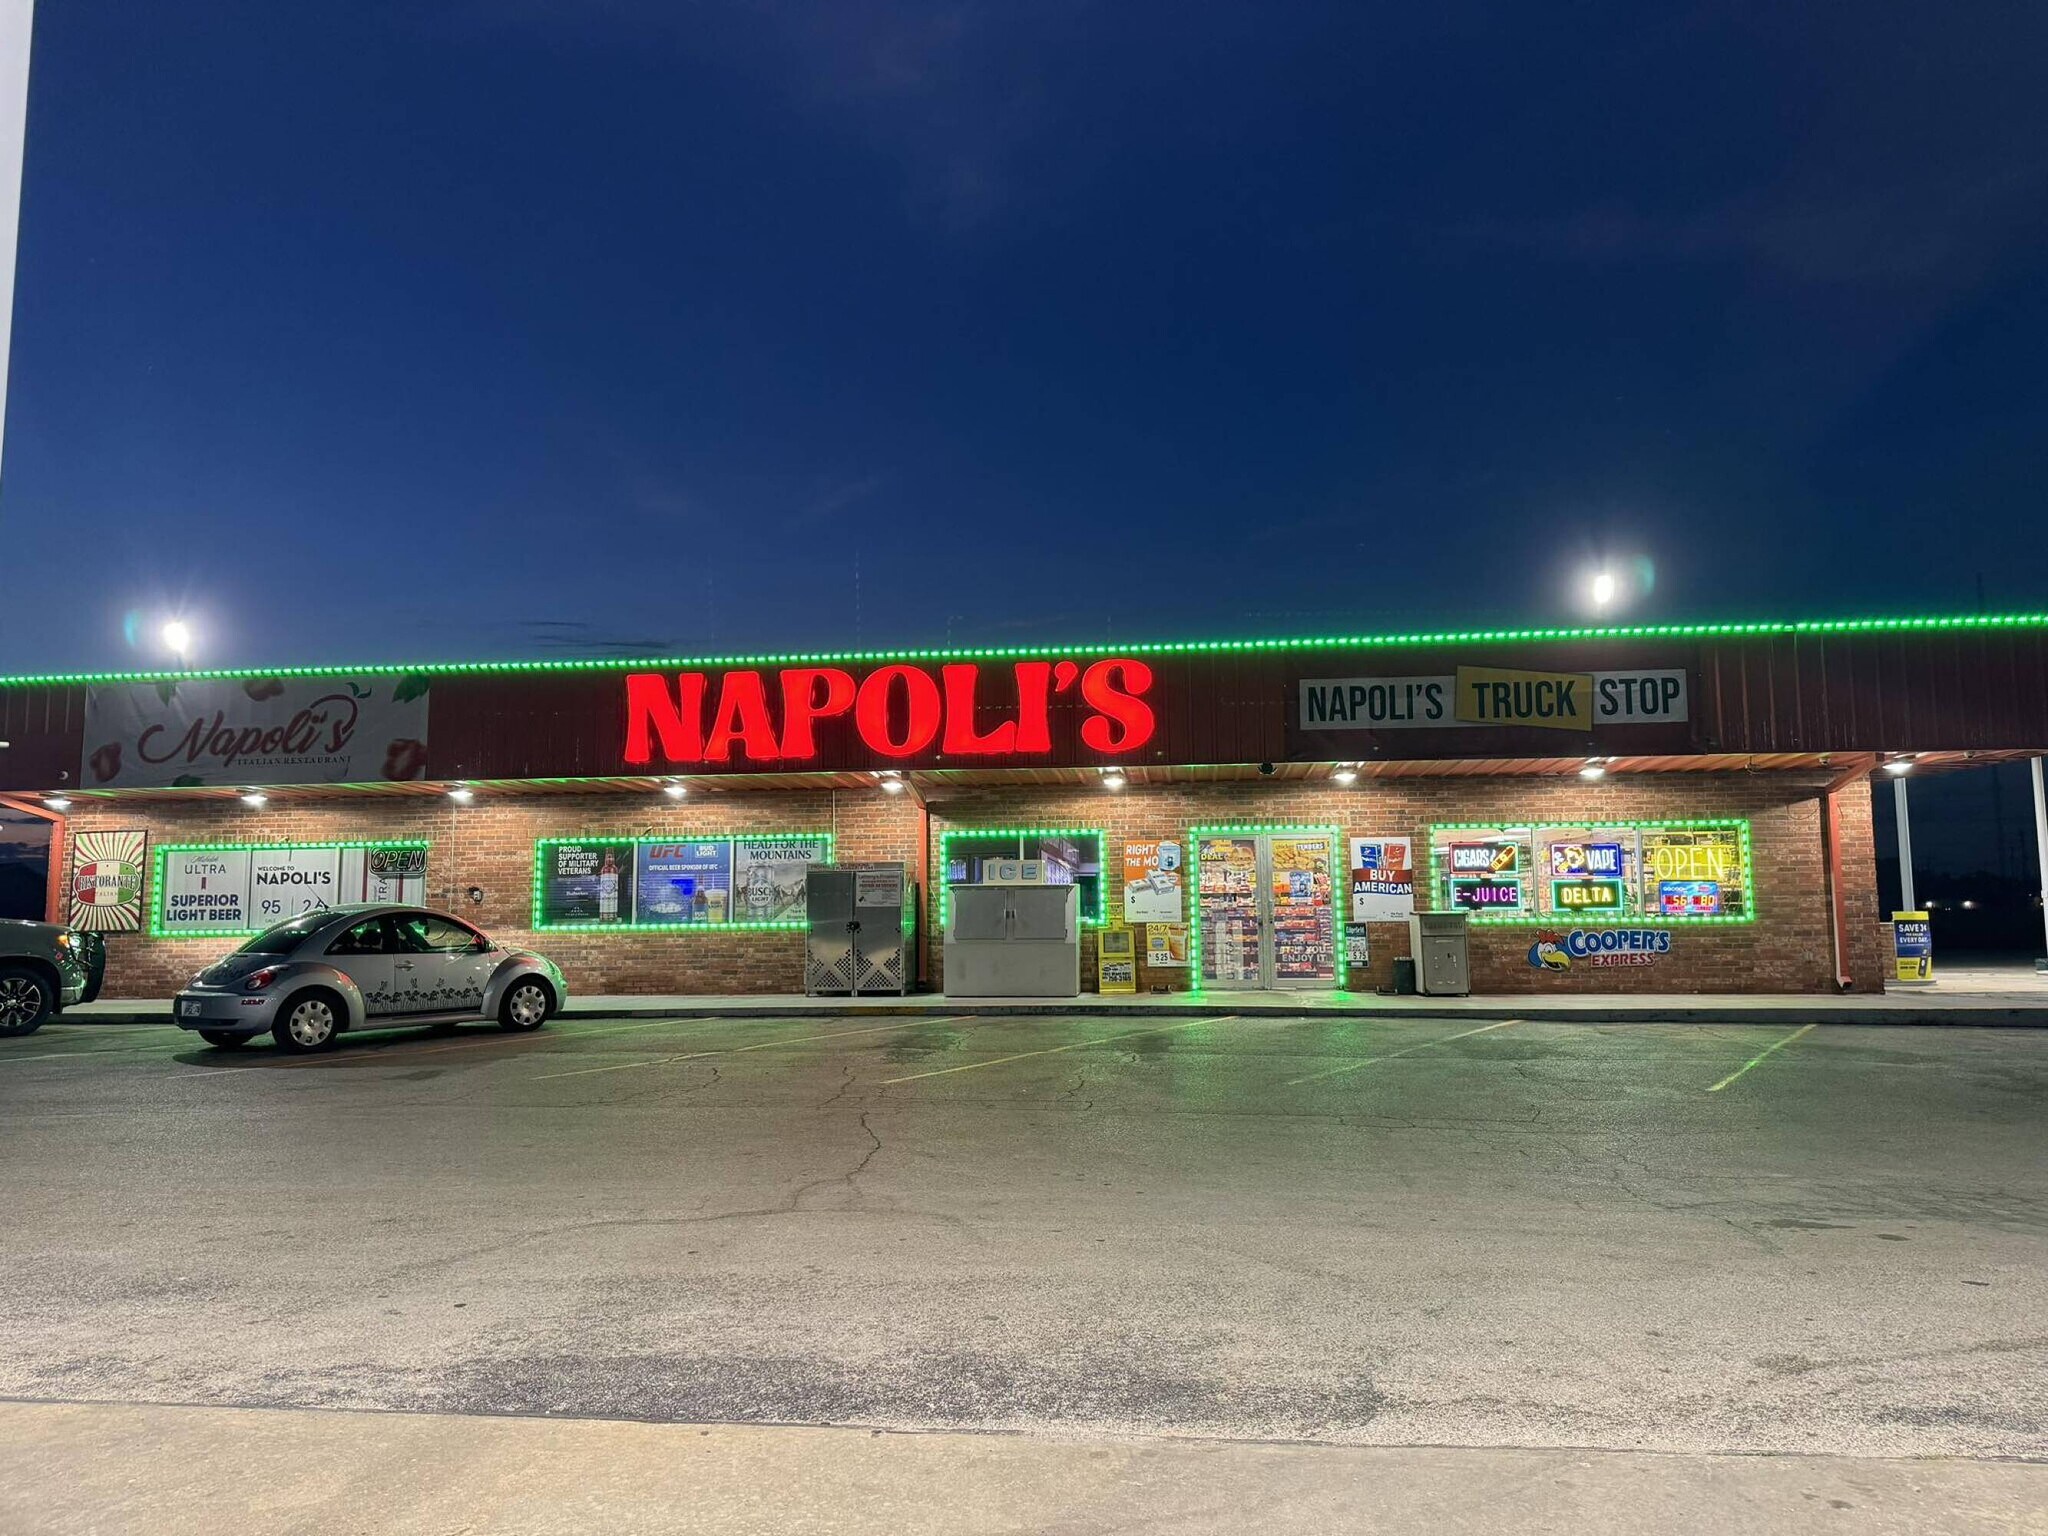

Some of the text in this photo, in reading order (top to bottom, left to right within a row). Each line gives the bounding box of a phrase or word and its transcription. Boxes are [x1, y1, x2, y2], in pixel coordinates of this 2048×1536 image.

[1308, 677, 1680, 722] NAPOLI'S TRUCK STOP
[623, 659, 1155, 763] NAPOLI'S
[138, 696, 359, 767] Napoli's
[237, 755, 351, 766] ITALIAN RESTAURANT
[743, 839, 819, 849] HEAD FOR THE
[1126, 844, 1156, 855] RIGHT
[558, 853, 597, 861] SUPPORTER
[649, 845, 687, 859] UFC
[750, 850, 812, 860] MOUNTAINS
[1454, 849, 1490, 867] CIGARS
[371, 850, 424, 869] OPEN
[1125, 857, 1141, 867] THE
[1586, 849, 1616, 870] VAPE
[1656, 848, 1725, 880] OPEN
[184, 864, 227, 875] ULTRA
[988, 864, 1038, 880] ICE
[1369, 869, 1396, 882] BUY
[79, 875, 136, 891] RISTORANTE
[256, 871, 331, 885] NAPOLI'S
[1354, 882, 1412, 894] AMERICAN
[1454, 886, 1517, 902] E-JUICE
[171, 894, 239, 907] SUPERIOR
[1131, 895, 1136, 904] $
[1359, 897, 1364, 906] $
[1562, 887, 1612, 904] DELTA
[262, 900, 281, 914] 95
[166, 909, 242, 921] LIGHT BEER
[1898, 923, 1919, 932] SAVE
[1568, 929, 1670, 957] COOPER'S
[1591, 953, 1656, 968] EXPRESS
